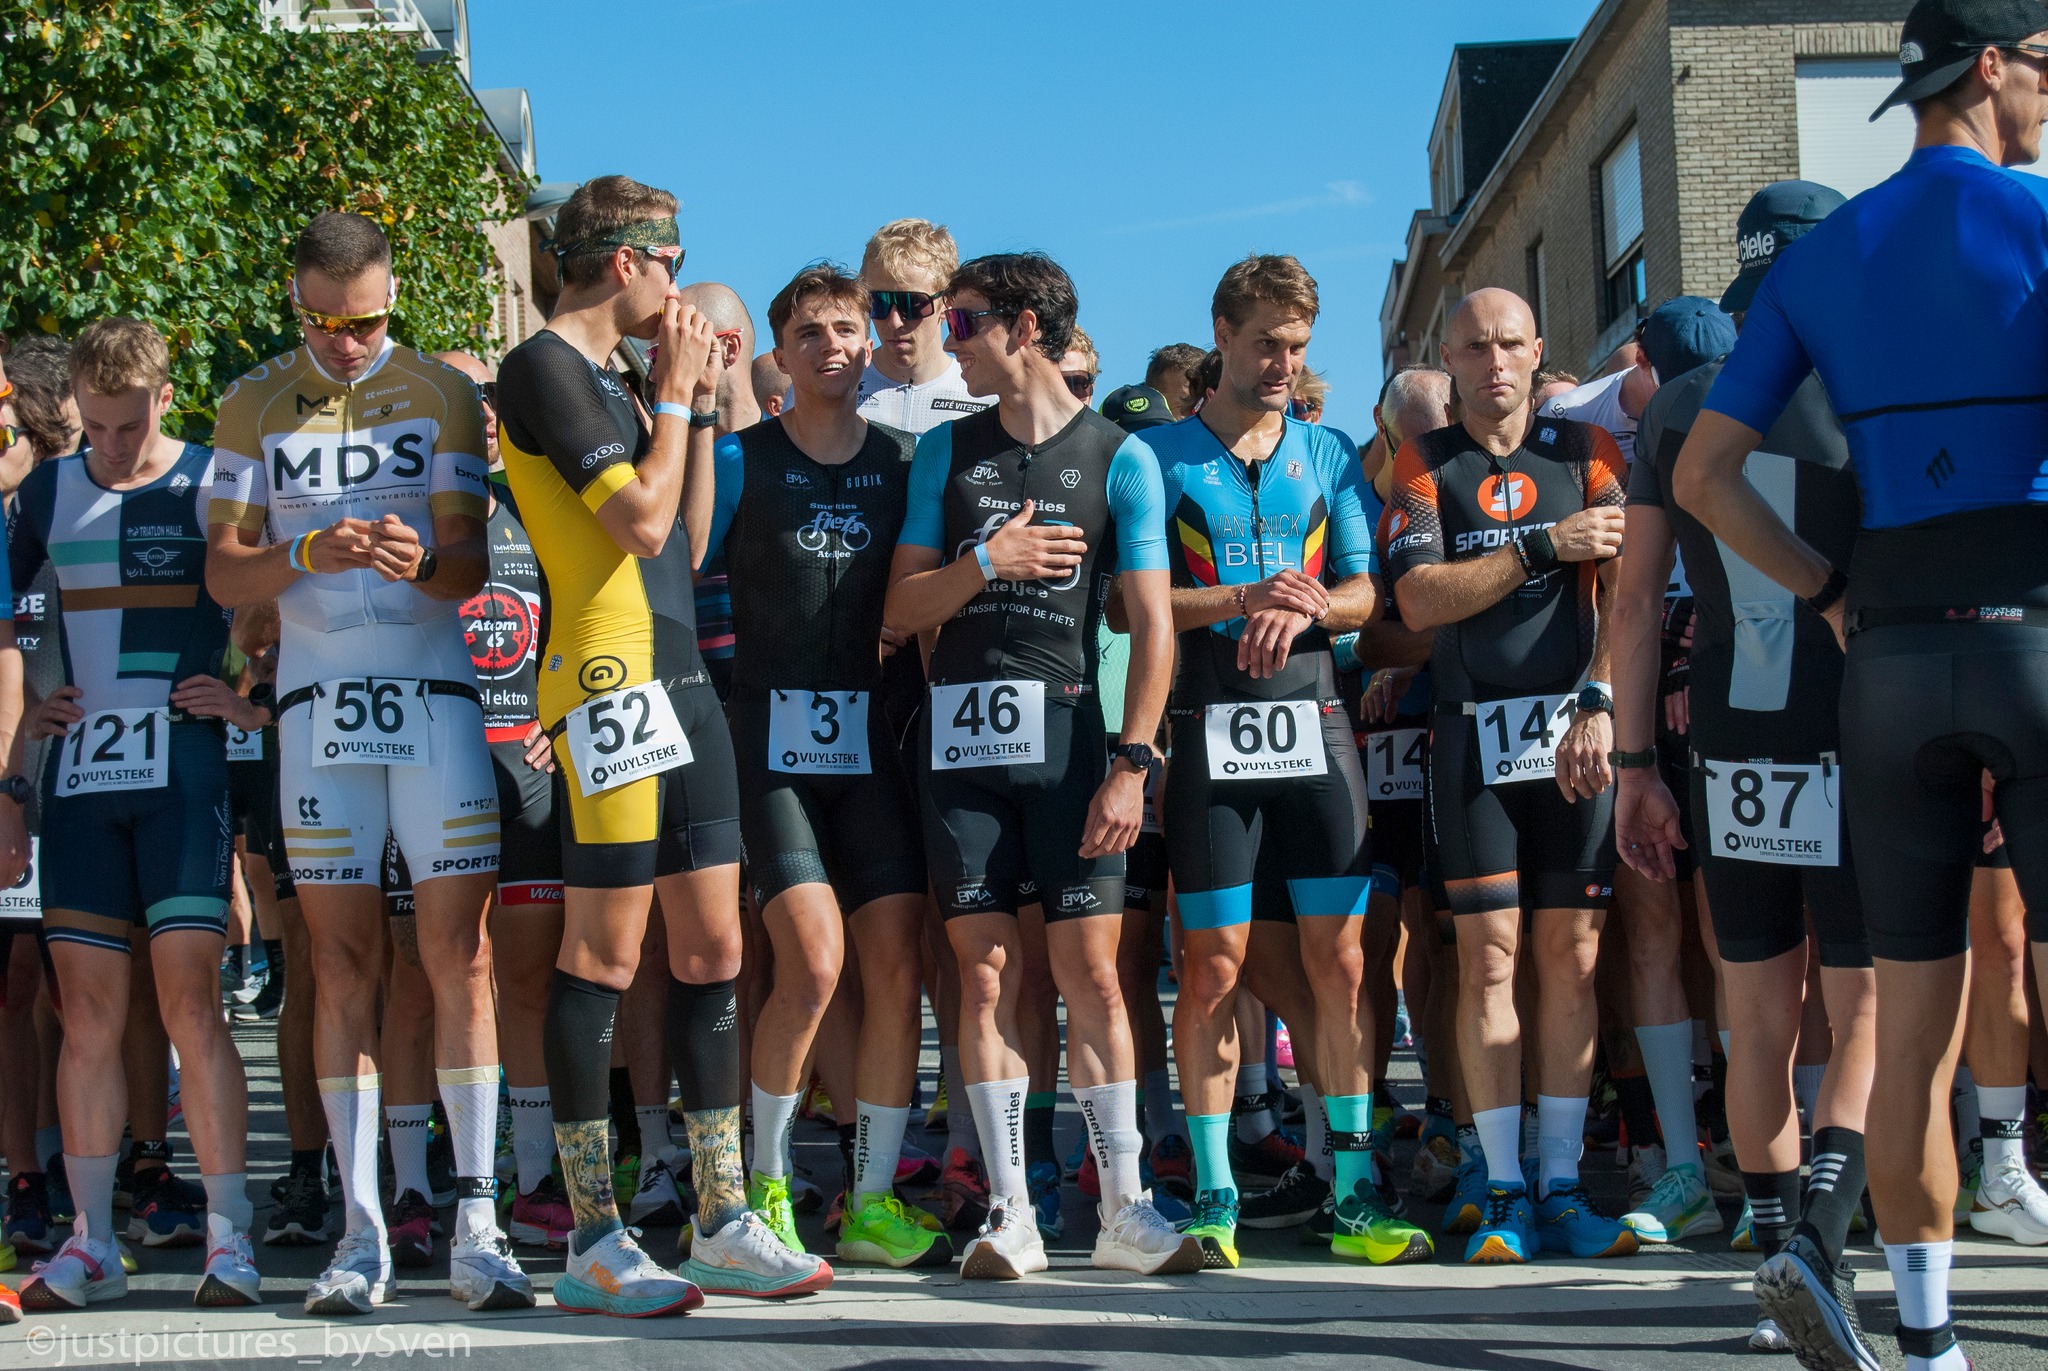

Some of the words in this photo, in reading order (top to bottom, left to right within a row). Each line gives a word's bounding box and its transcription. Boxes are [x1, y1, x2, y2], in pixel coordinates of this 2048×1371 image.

[1740, 231, 1775, 262] ciele
[1745, 257, 1772, 269] ATHLETICS
[934, 401, 954, 409] CAFÉ
[274, 433, 425, 491] MDS
[847, 474, 882, 489] GOBIK
[279, 501, 307, 510] ramen
[375, 490, 426, 501] veranda's
[978, 496, 1066, 514] Smeties
[140, 526, 166, 537] TRIATLON
[166, 525, 182, 536] HALLE
[1211, 513, 1245, 539] VAN
[1456, 522, 1557, 552] SPORT
[493, 544, 530, 552] IMMOSEED
[1224, 541, 1295, 567] BEL
[151, 568, 184, 578] Louyet
[497, 569, 538, 578] LAUWERS
[504, 562, 533, 570] SPORT
[968, 603, 998, 616] PASSIE
[1001, 603, 1030, 615] VOOR
[1033, 608, 1047, 619] DE
[1049, 612, 1075, 627] FIETS
[467, 620, 517, 632] Atom
[487, 632, 504, 647] 6
[333, 682, 404, 734] 56
[952, 685, 1021, 737] 46
[588, 692, 658, 755] 52
[810, 697, 840, 745] 3
[1229, 705, 1297, 755] 60
[69, 712, 156, 767] 121
[341, 742, 415, 756] VUYLSTEKE
[962, 742, 1031, 757] VUYLSTEKE
[608, 744, 678, 775] VUYLSTEKE
[800, 752, 859, 764] VUYLSTEKE
[1240, 758, 1313, 771] VUYLSTEKE
[1513, 756, 1555, 771] VUYLS
[82, 768, 154, 783] VUYLSTEKE
[1731, 769, 1809, 829] 87
[220, 841, 230, 863] Den
[1742, 835, 1822, 853] VUYLSTEKE
[218, 865, 227, 886] Van
[1003, 1091, 1021, 1167] Smetties
[1080, 1099, 1109, 1169] Smetties
[857, 1113, 871, 1183] Smetties
